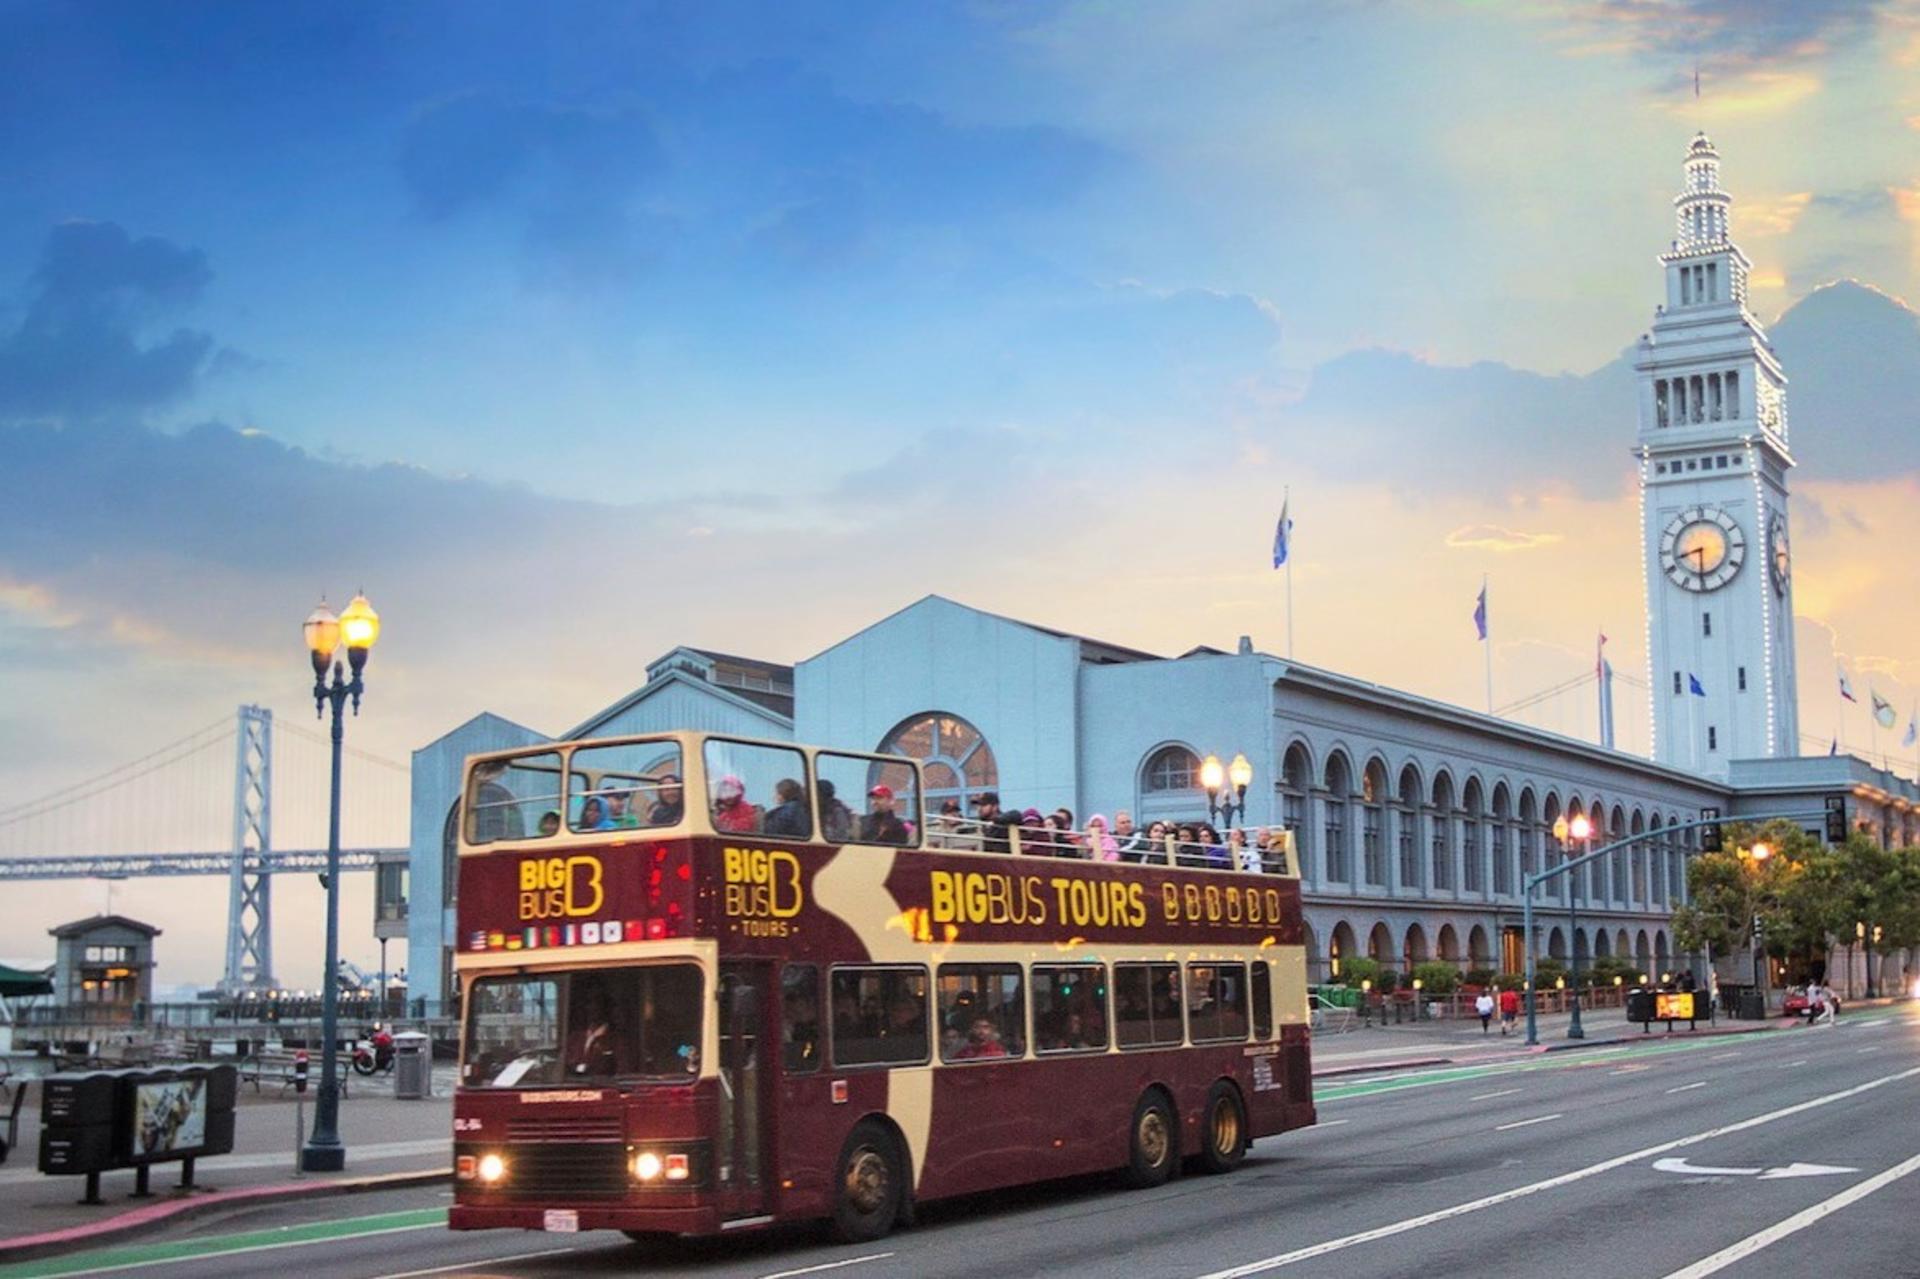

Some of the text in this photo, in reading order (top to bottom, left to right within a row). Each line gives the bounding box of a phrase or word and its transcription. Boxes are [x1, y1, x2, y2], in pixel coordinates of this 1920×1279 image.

[520, 858, 565, 890] BIG
[723, 847, 768, 884] BIG
[520, 890, 564, 919] BUS
[726, 885, 768, 917] BUS
[1051, 878, 1146, 927] TOURS
[742, 920, 788, 937] TOURS
